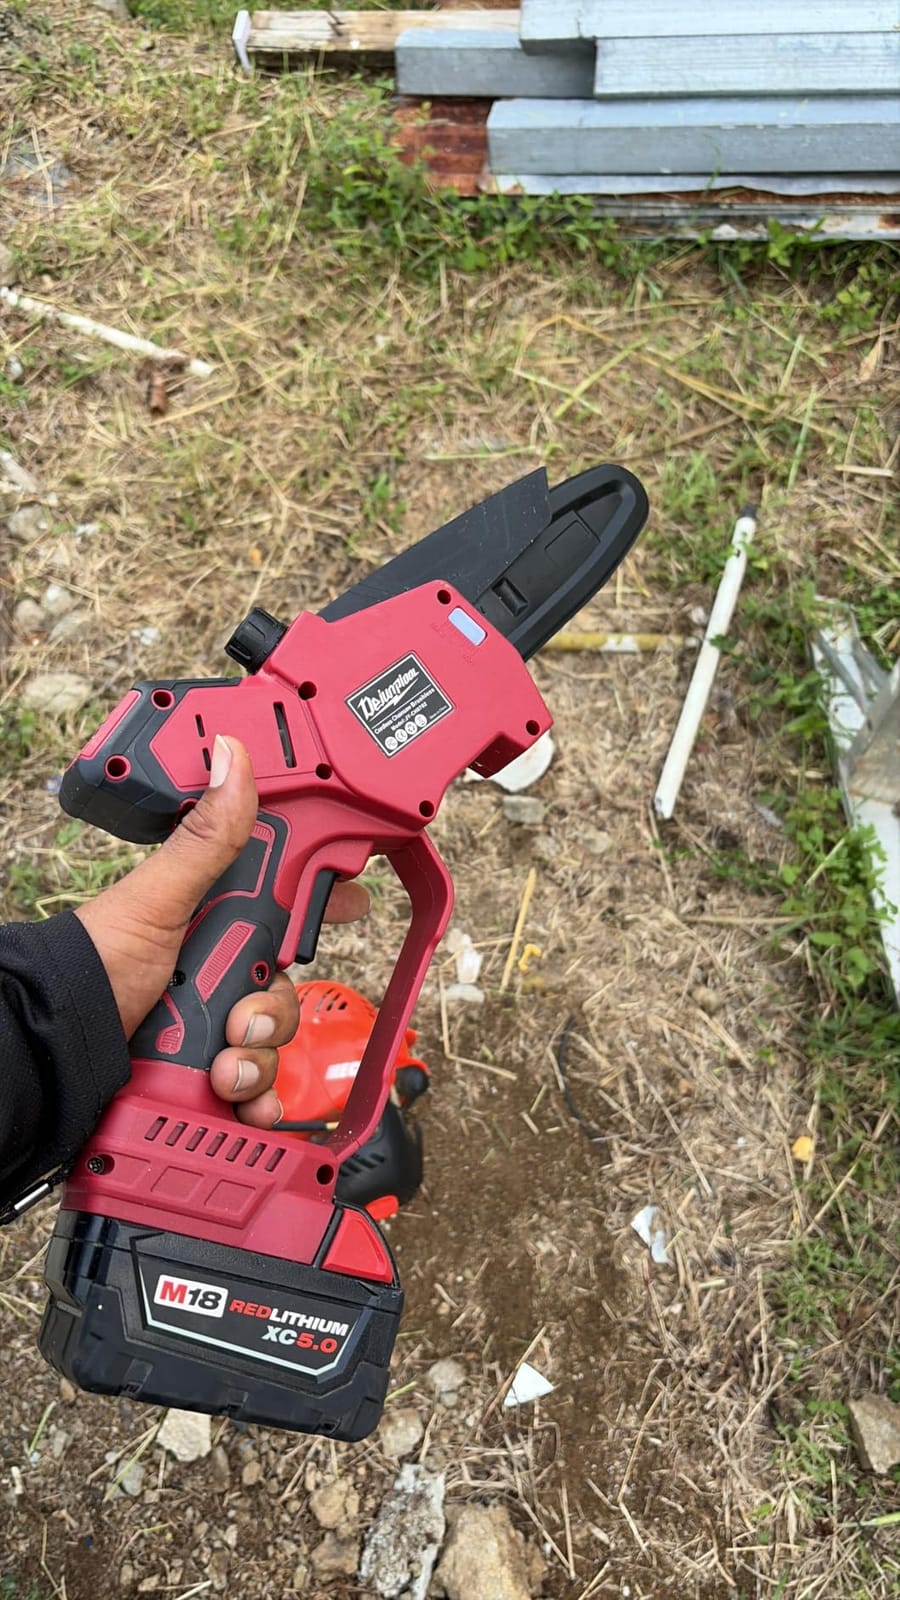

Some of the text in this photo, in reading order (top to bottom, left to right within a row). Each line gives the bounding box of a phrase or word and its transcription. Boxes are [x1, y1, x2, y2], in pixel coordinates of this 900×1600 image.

[374, 719, 393, 735] Cordless
[410, 687, 435, 708] Brushless
[159, 1280, 350, 1337] M18 REDLITHIUM
[261, 1325, 338, 1354] XC5.0
